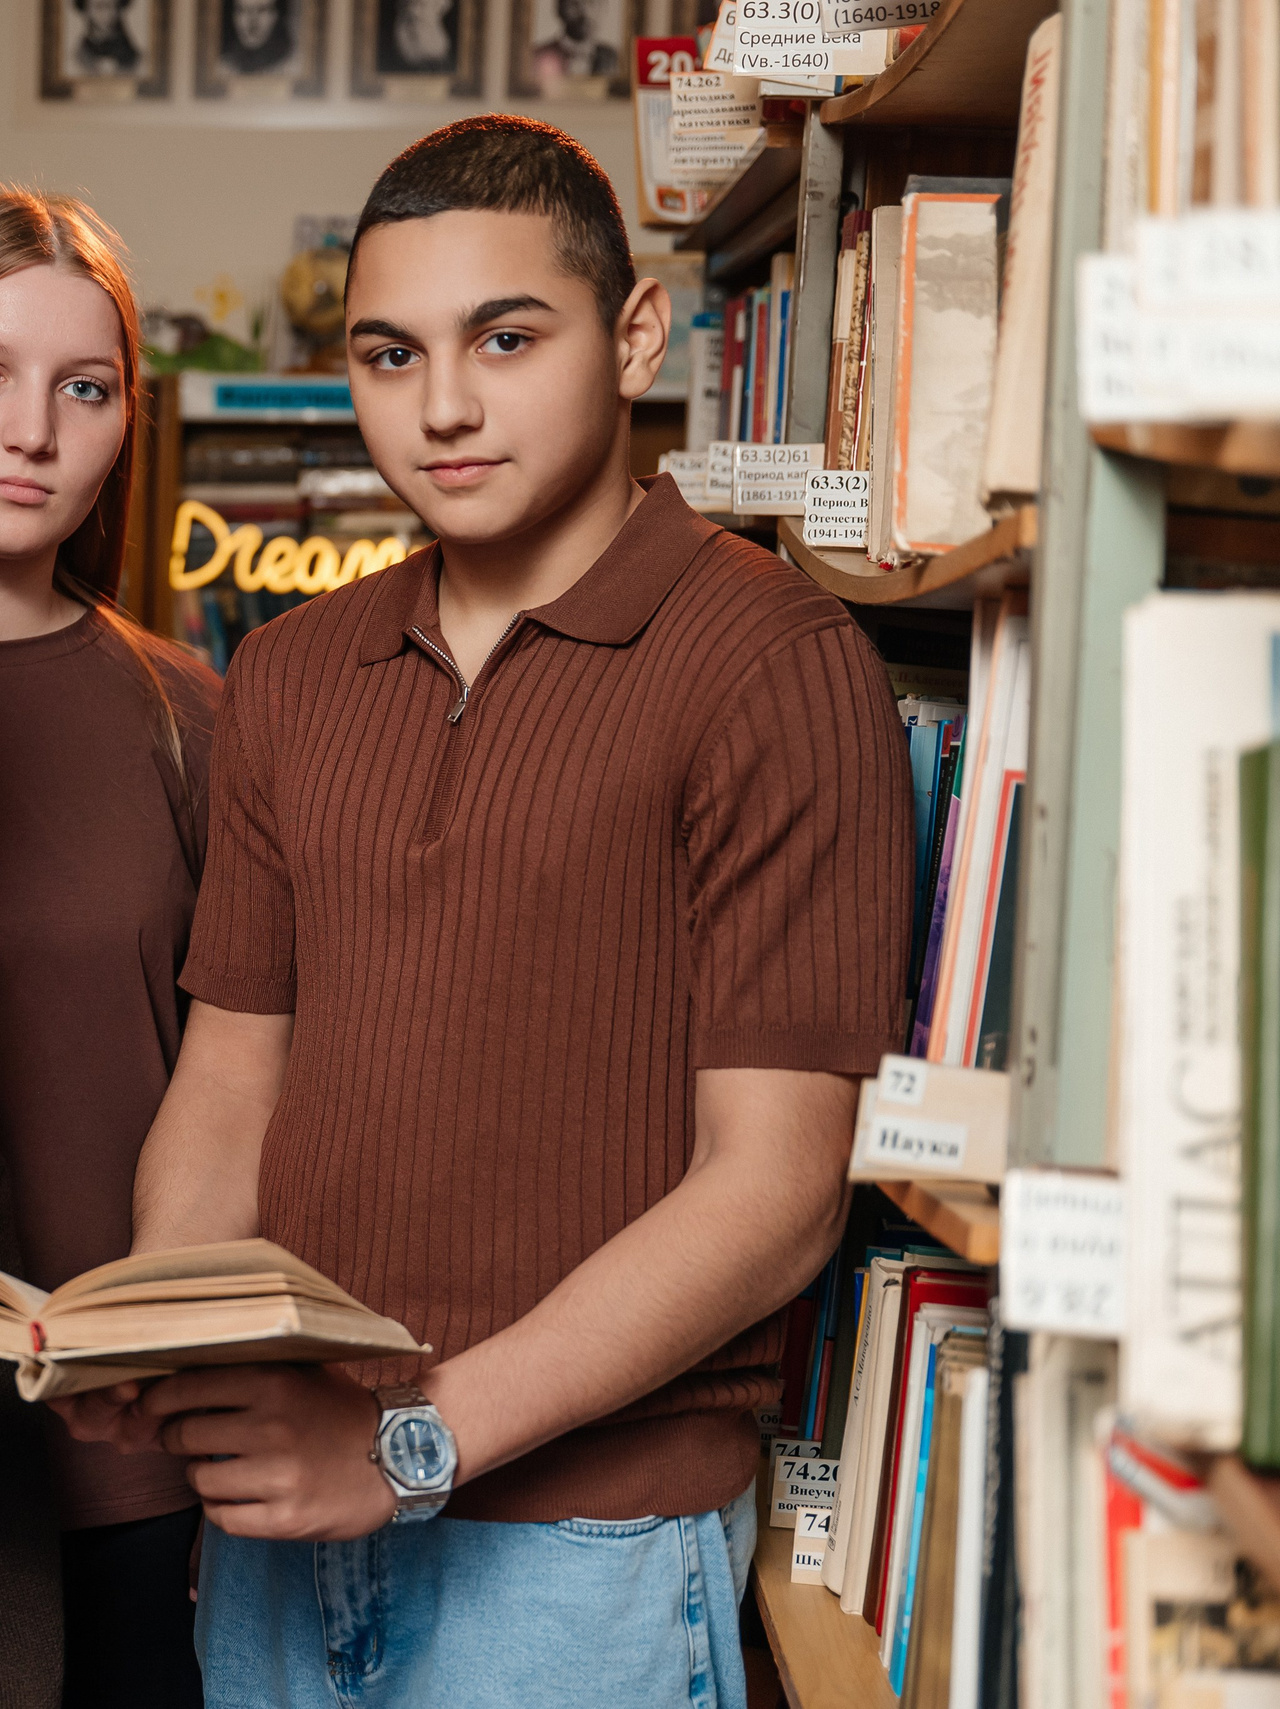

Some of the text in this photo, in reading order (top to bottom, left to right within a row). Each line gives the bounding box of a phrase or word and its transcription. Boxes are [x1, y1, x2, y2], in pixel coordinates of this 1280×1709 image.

[743, 1, 820, 24] 63.3(0)
[739, 31, 816, 47] Средние
[676, 76, 722, 88] 74.262
[676, 93, 736, 103] Методика
[672, 104, 757, 117] преподавания
[678, 118, 751, 129] математики
[740, 449, 809, 465] 63.3(2)61
[739, 470, 784, 483] Период
[810, 475, 868, 494] 63.3(2)
[741, 490, 806, 502] (1861-1917
[812, 497, 856, 510] Период
[807, 528, 868, 541] (1941-194
[889, 1071, 917, 1096] 72
[877, 1127, 961, 1162] Наука
[760, 1413, 783, 1425] Об
[775, 1443, 821, 1458] 742
